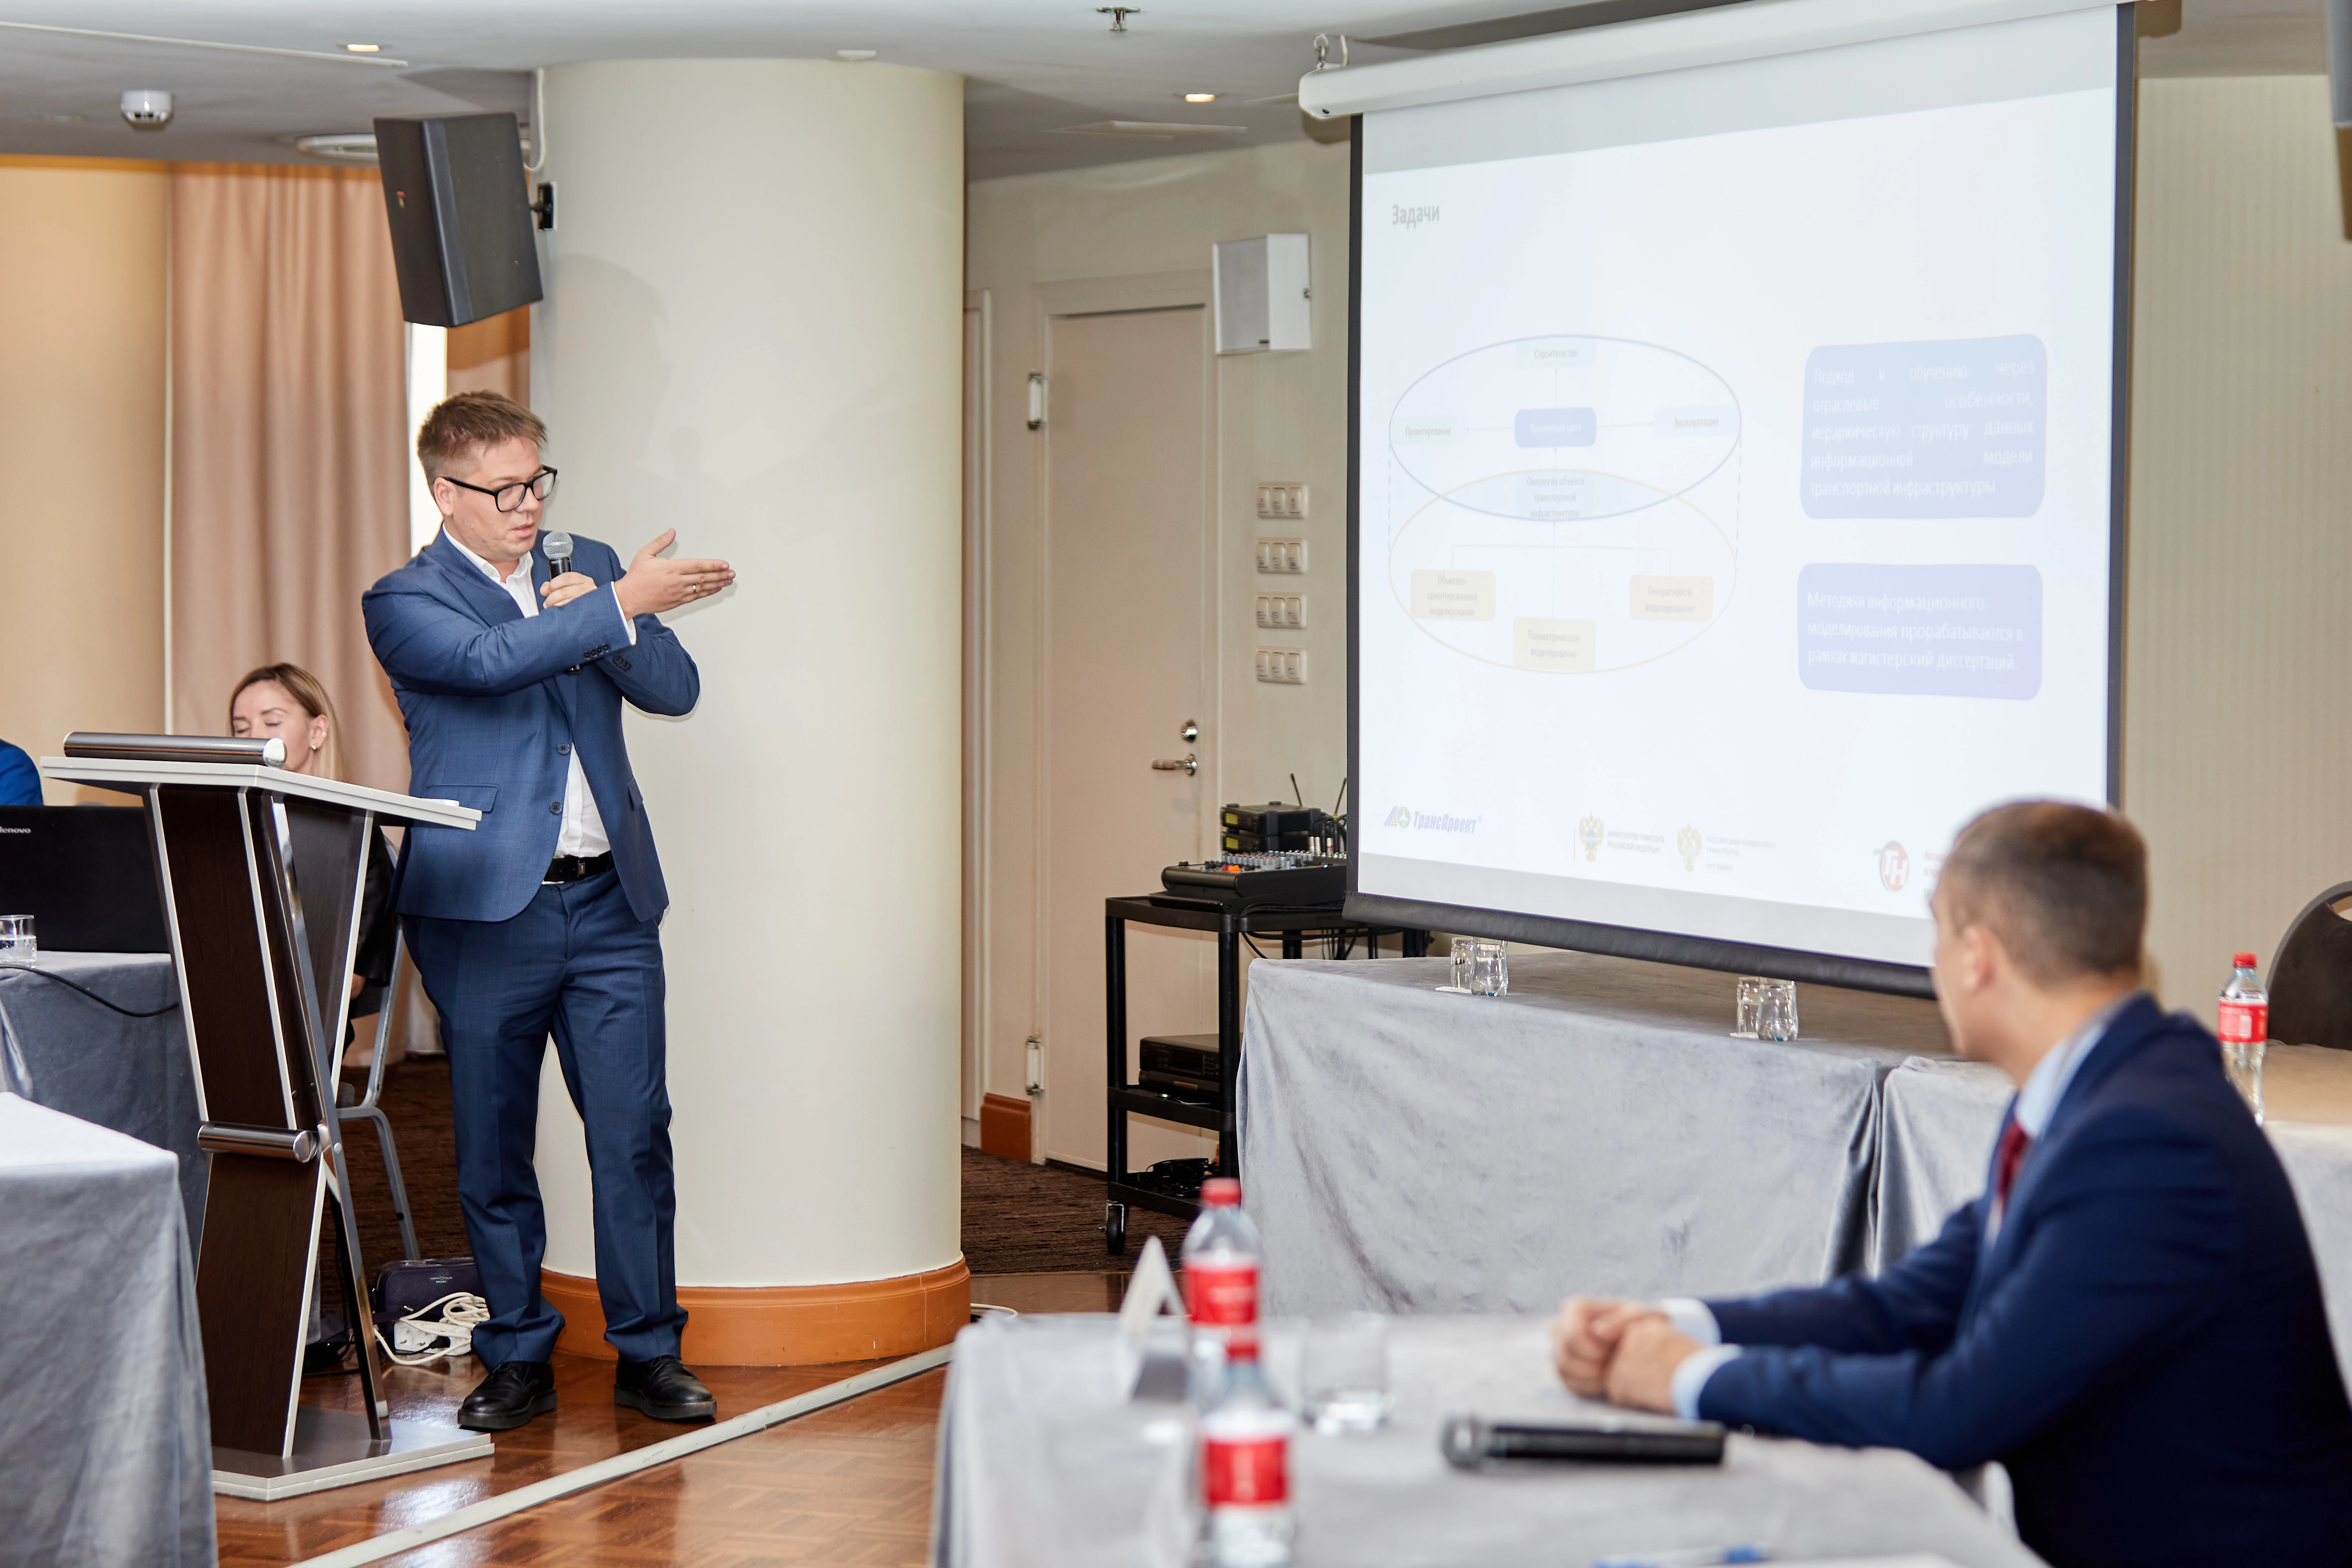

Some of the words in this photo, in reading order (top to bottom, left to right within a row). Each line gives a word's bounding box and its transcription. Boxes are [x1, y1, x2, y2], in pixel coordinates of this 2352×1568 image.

[1392, 204, 1440, 229] Задачи
[1534, 348, 1578, 361] Строительство
[1814, 369, 1855, 386] Подход
[1879, 369, 1885, 381] к
[1910, 364, 1968, 384] обучению
[1996, 361, 2034, 378] через
[1813, 397, 1879, 416] отраслевые
[1945, 391, 2033, 408] особенности,
[1674, 417, 1719, 429] Эксплуатация
[1405, 426, 1451, 438] Проектирование
[1812, 425, 1900, 444] иерархическую
[1911, 423, 1969, 442] структуру
[1984, 421, 2034, 438] данных
[1811, 451, 1913, 472] информационной
[1983, 451, 2033, 467] модели
[1527, 476, 1558, 486] Онтология
[1559, 475, 1584, 486] объекта
[1811, 478, 1891, 500] транспортной
[1893, 478, 1996, 499] инфраструктуры
[1534, 492, 1576, 504] транспортной
[1531, 507, 1580, 519] инфраструктуры
[1437, 574, 1467, 585] Объектно-
[1427, 592, 1477, 603] ориентированное
[1807, 593, 1865, 611] Методики
[1868, 593, 1985, 614] информационного
[1430, 607, 1475, 618] моделирование
[1528, 629, 1580, 643] Параметрическое
[1808, 623, 1897, 640] моделирования
[1901, 622, 2013, 643] прорабатываются
[2016, 629, 2023, 642] в
[1531, 648, 1577, 660] моделирование
[1808, 650, 1847, 666] рамках
[1850, 650, 1934, 670] магистерский
[1937, 653, 2017, 672] диссертаций.
[1414, 811, 1477, 834] ТрансПроект
